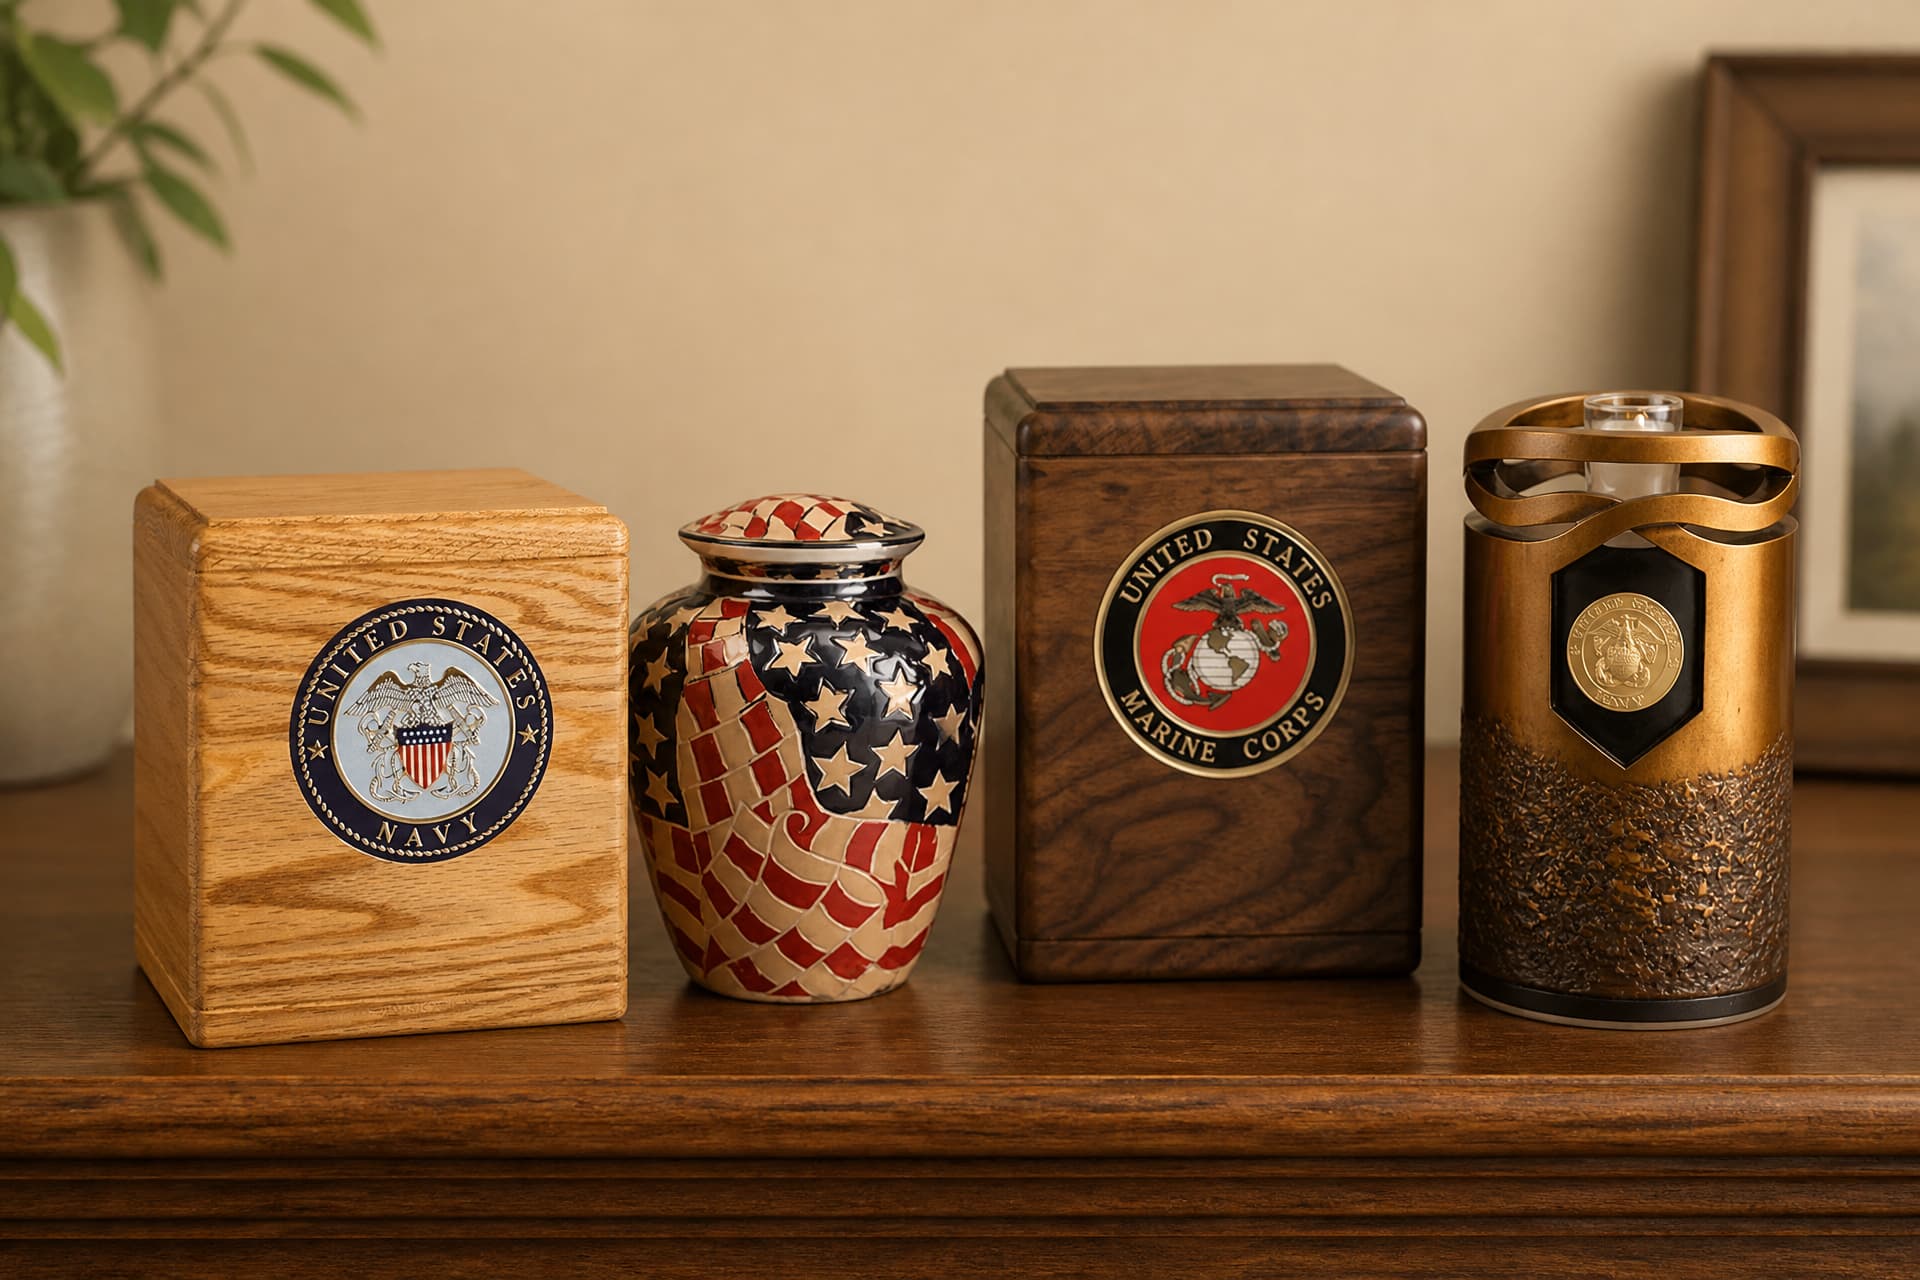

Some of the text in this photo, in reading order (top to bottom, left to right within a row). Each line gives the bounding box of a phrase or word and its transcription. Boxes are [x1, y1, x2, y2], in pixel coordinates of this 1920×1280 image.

[1119, 528, 1333, 610] UNITED STATES
[308, 616, 536, 726] UNITED STATES
[1120, 689, 1325, 763] MARINE CORPS
[376, 812, 478, 847] NAVY
